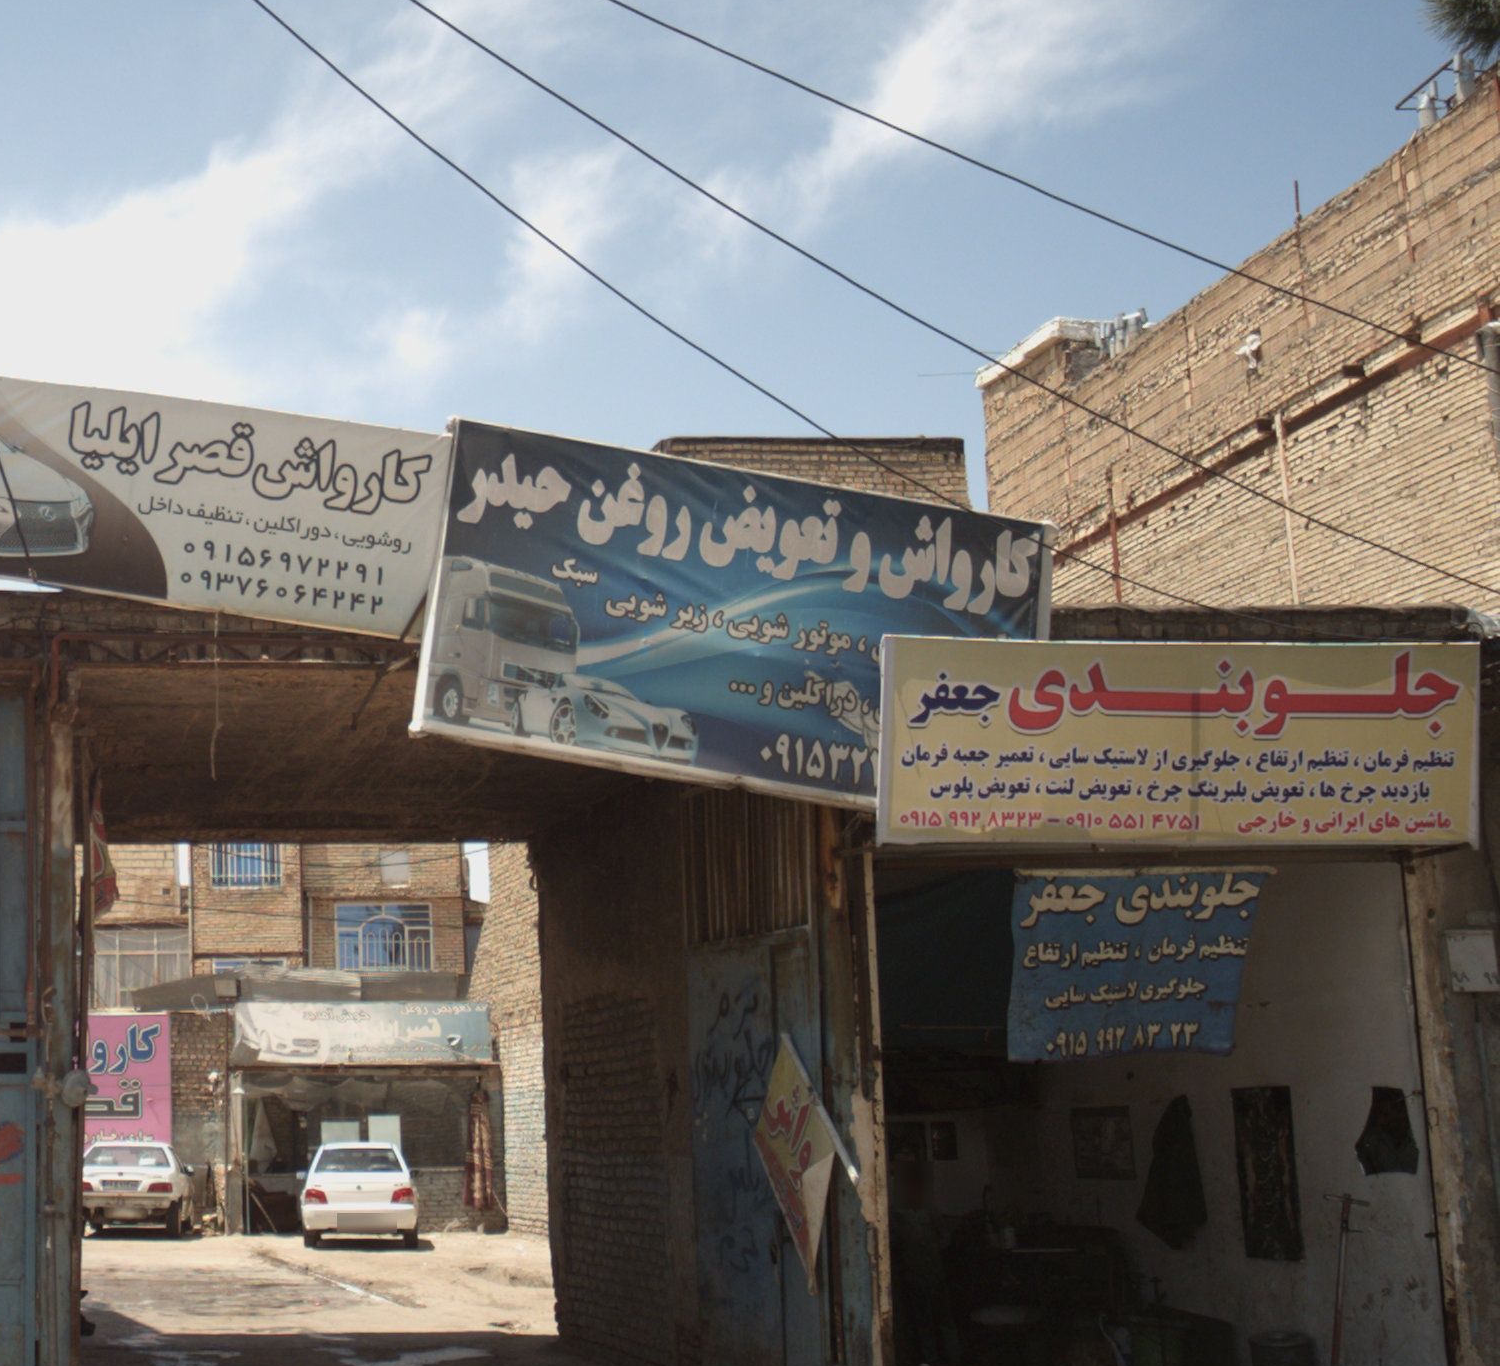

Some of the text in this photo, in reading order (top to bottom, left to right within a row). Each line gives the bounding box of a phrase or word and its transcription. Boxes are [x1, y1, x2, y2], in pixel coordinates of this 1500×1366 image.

[69, 401, 432, 514] کارواش قصر ایلیا
[138, 496, 183, 514] داخل
[187, 503, 243, 525] تنظیف
[457, 453, 1040, 614] کارواش و تعویض روغن حیدر
[552, 558, 598, 586] سبک
[605, 593, 667, 622] شویی
[671, 603, 709, 632] زیر
[727, 614, 789, 643] شویی
[793, 622, 851, 654] موتور
[759, 682, 773, 706] و
[908, 672, 1001, 725] جعفر
[901, 743, 948, 767] فرمان
[953, 746, 990, 767] جعبه
[997, 747, 1034, 768] تعمیر
[1049, 747, 1089, 769] سایی
[1093, 748, 1148, 769] لاستیک
[1152, 749, 1168, 770] از
[1172, 750, 1240, 772] جلوگیری
[1255, 750, 1303, 772] ارتفاع
[1307, 751, 1348, 772] تنظیم
[1363, 750, 1409, 773] فرمان
[1413, 751, 1455, 771] تنظیم
[930, 776, 974, 799] پلوس
[977, 777, 1031, 799] تعویض
[1046, 777, 1074, 794] لنت
[1078, 778, 1131, 801] تعویض
[1146, 780, 1182, 802] چرخ
[1251, 781, 1304, 803] تعویض
[1320, 781, 1335, 797] ها
[1340, 781, 1376, 803] چرخ
[1380, 782, 1430, 803] بازدید
[1237, 811, 1451, 833] ماشین های ایرانی و خارجی
[1020, 876, 1108, 927] جعفر
[1023, 942, 1077, 968] ارتفاع
[1081, 941, 1128, 966] تنظیم
[1148, 935, 1195, 962] فرمان
[1199, 936, 1249, 958] تنظیم
[1090, 981, 1138, 1005] لاستیک
[1139, 978, 1206, 1001] جلوگیری
[86, 1023, 160, 1074] کارو
